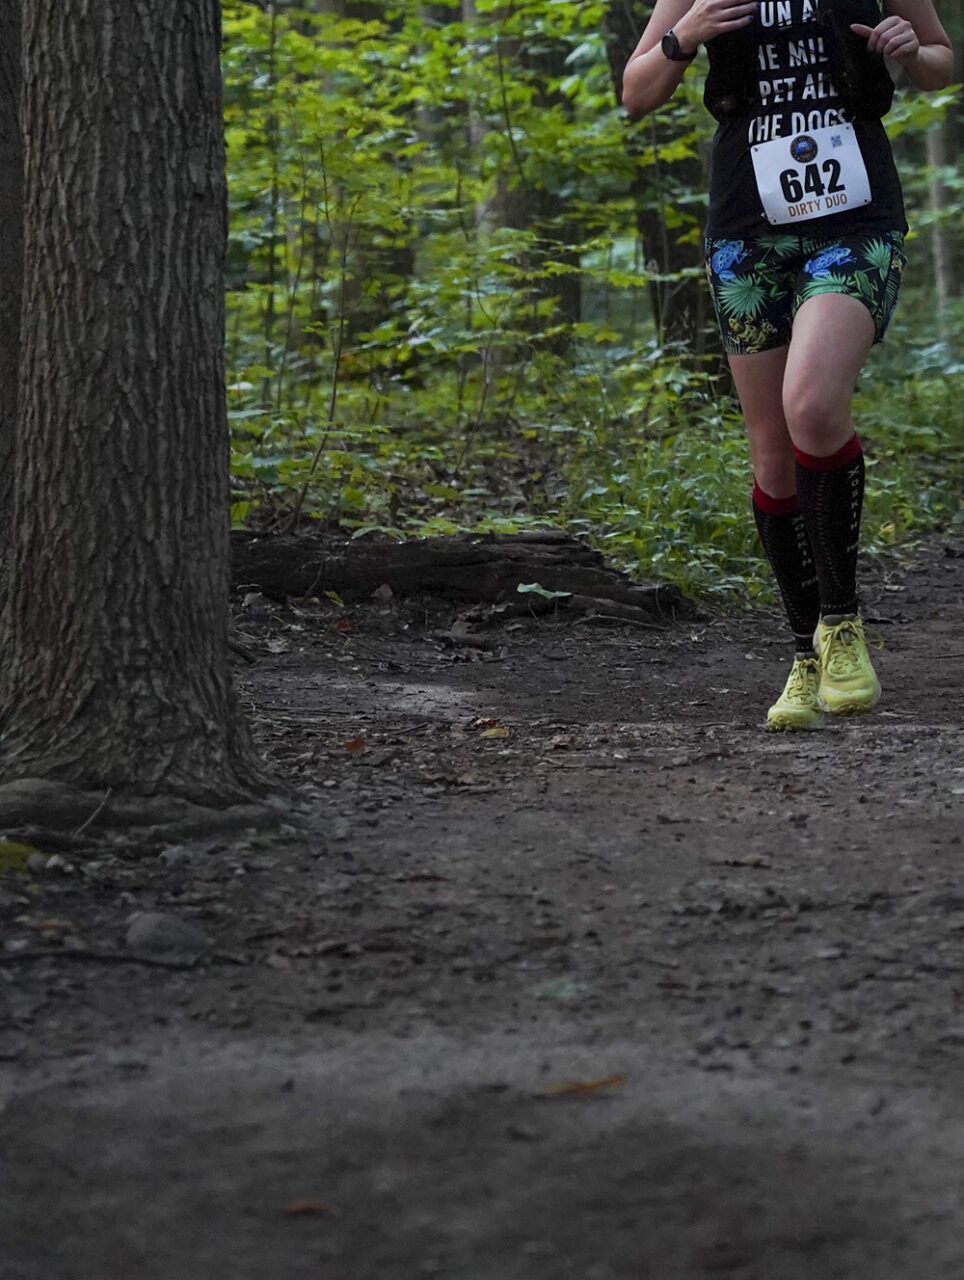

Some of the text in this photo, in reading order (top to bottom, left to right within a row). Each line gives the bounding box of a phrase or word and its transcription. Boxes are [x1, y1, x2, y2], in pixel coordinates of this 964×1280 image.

[760, 0, 792, 28] UN
[788, 37, 829, 68] MIL
[758, 72, 839, 106] PET ALL
[791, 108, 847, 135] DOGS
[779, 158, 846, 204] 642
[787, 193, 848, 218] DIRTY DUO
